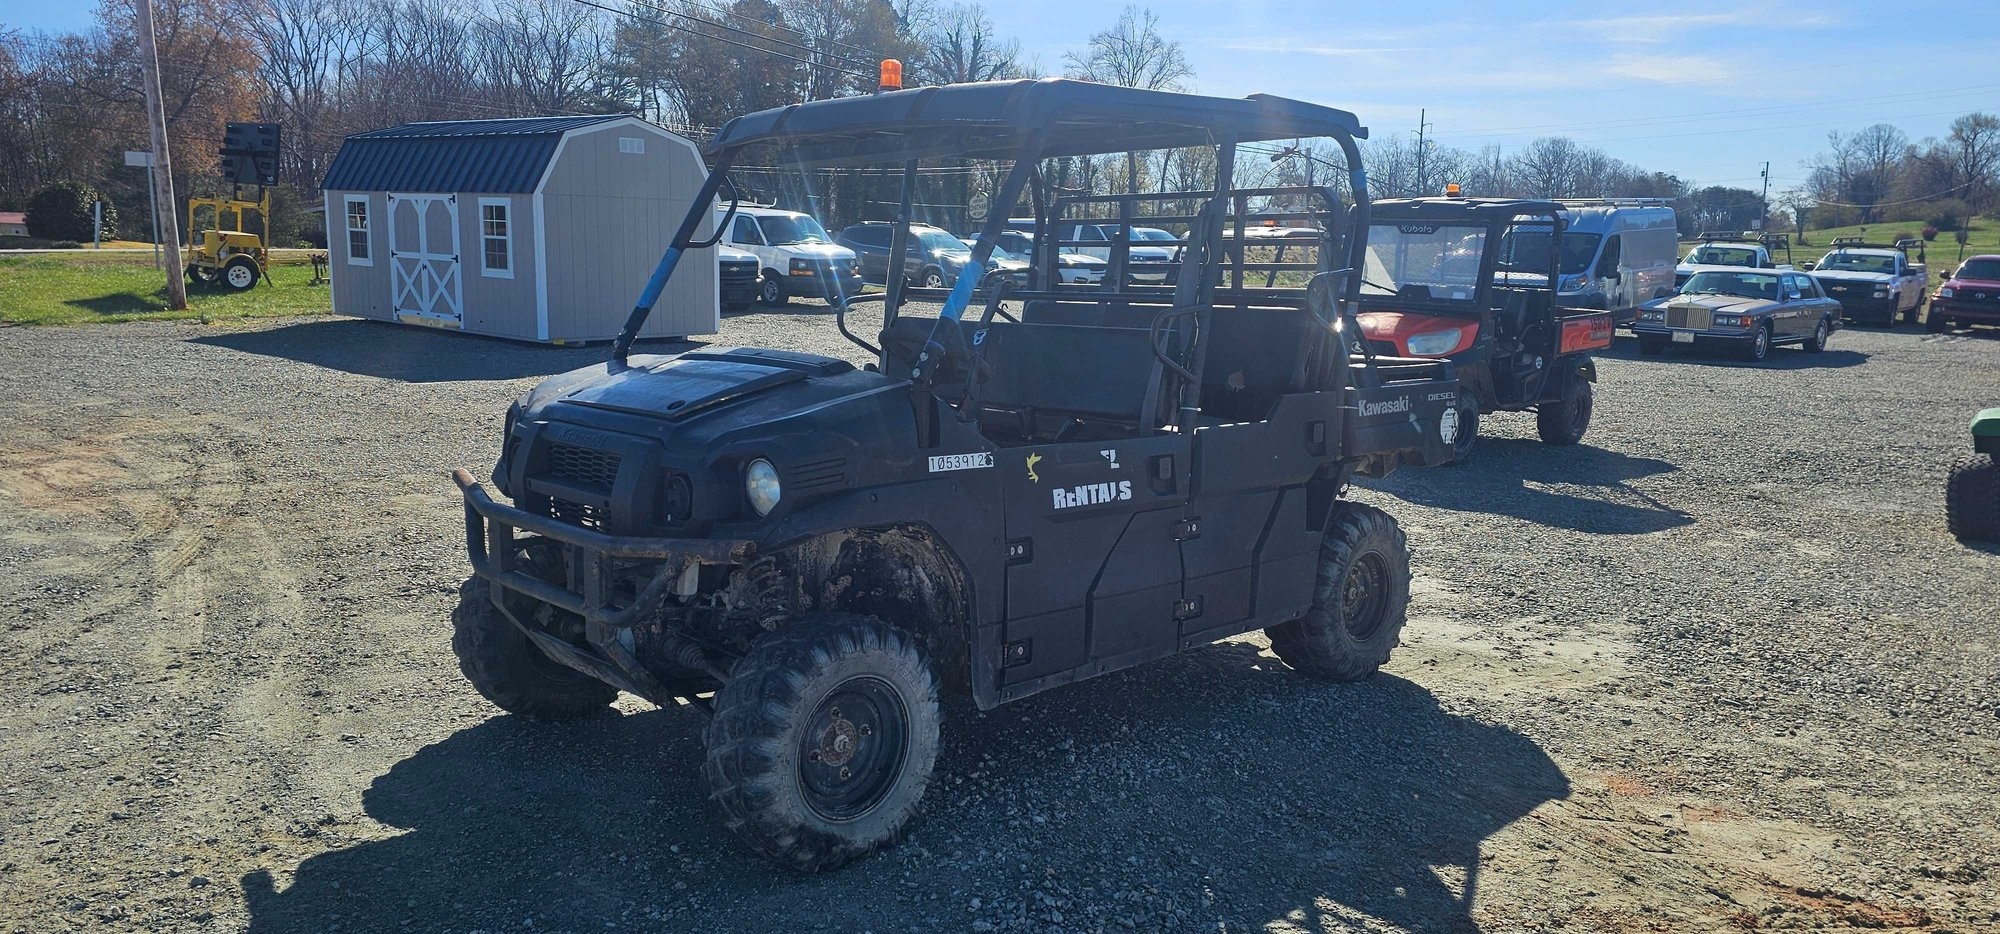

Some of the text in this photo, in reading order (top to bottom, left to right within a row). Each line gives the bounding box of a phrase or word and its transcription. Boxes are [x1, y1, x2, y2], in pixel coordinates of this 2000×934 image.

[1401, 224, 1433, 233] Kubota
[1428, 391, 1457, 401] DIESEL
[1358, 395, 1409, 417] Kawasaki
